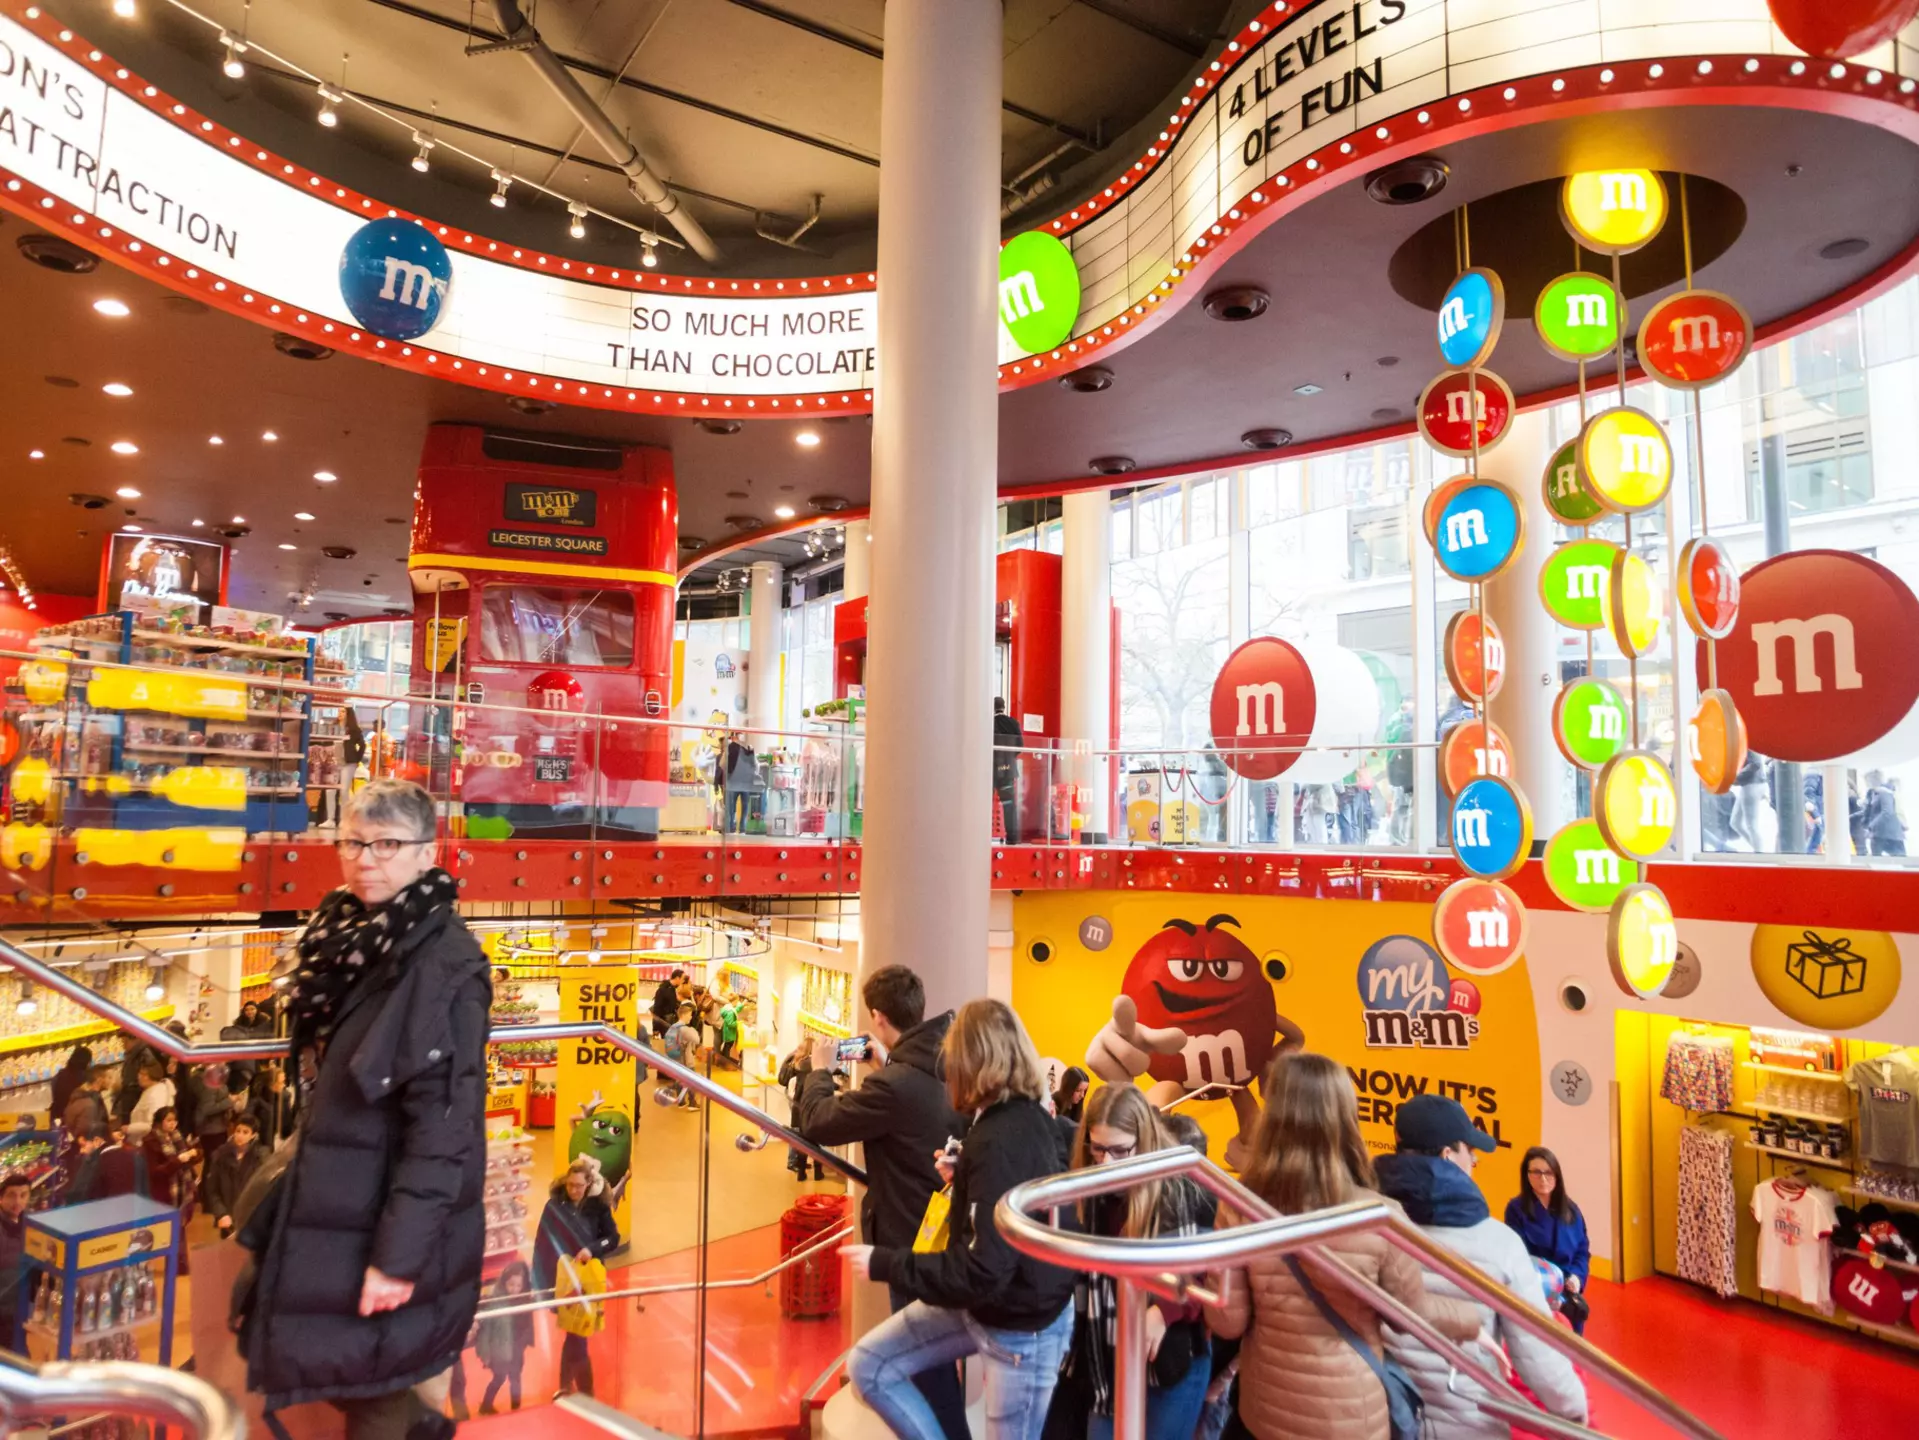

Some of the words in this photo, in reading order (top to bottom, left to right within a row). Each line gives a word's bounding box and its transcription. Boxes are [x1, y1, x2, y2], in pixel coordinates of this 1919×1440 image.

[1229, 84, 1245, 119] 4
[1255, 0, 1406, 103] LEVELS
[1243, 110, 1284, 167] OF
[1302, 57, 1382, 130] FUN
[0, 106, 237, 259] ATTRACTION
[1600, 173, 1647, 211] m
[379, 256, 432, 310] m
[632, 307, 671, 331] SO
[685, 312, 769, 337] MUCH
[782, 308, 864, 336] MORE
[1438, 297, 1468, 344] m
[1566, 294, 1608, 326] m
[1671, 315, 1720, 353] m
[607, 343, 692, 374] THAN
[1446, 390, 1487, 423] m
[1618, 434, 1666, 475] m
[491, 531, 552, 548] LEICESTER
[555, 538, 603, 552] SQUARE
[1446, 508, 1489, 552] m
[1751, 613, 1863, 697] m
[543, 688, 568, 710] m
[1236, 681, 1286, 736] m
[1588, 705, 1622, 740] m
[541, 769, 563, 780] BUS
[1456, 808, 1491, 847] m
[1574, 849, 1620, 884] m
[1087, 924, 1104, 943] m
[1466, 911, 1509, 948] m
[578, 983, 636, 1003] SHOP
[1367, 959, 1445, 1016] my
[1453, 990, 1470, 1009] m
[578, 1004, 625, 1023] TILL
[1179, 1029, 1251, 1089] m
[1346, 1066, 1429, 1099] NOW
[1438, 1080, 1498, 1114] IT'S
